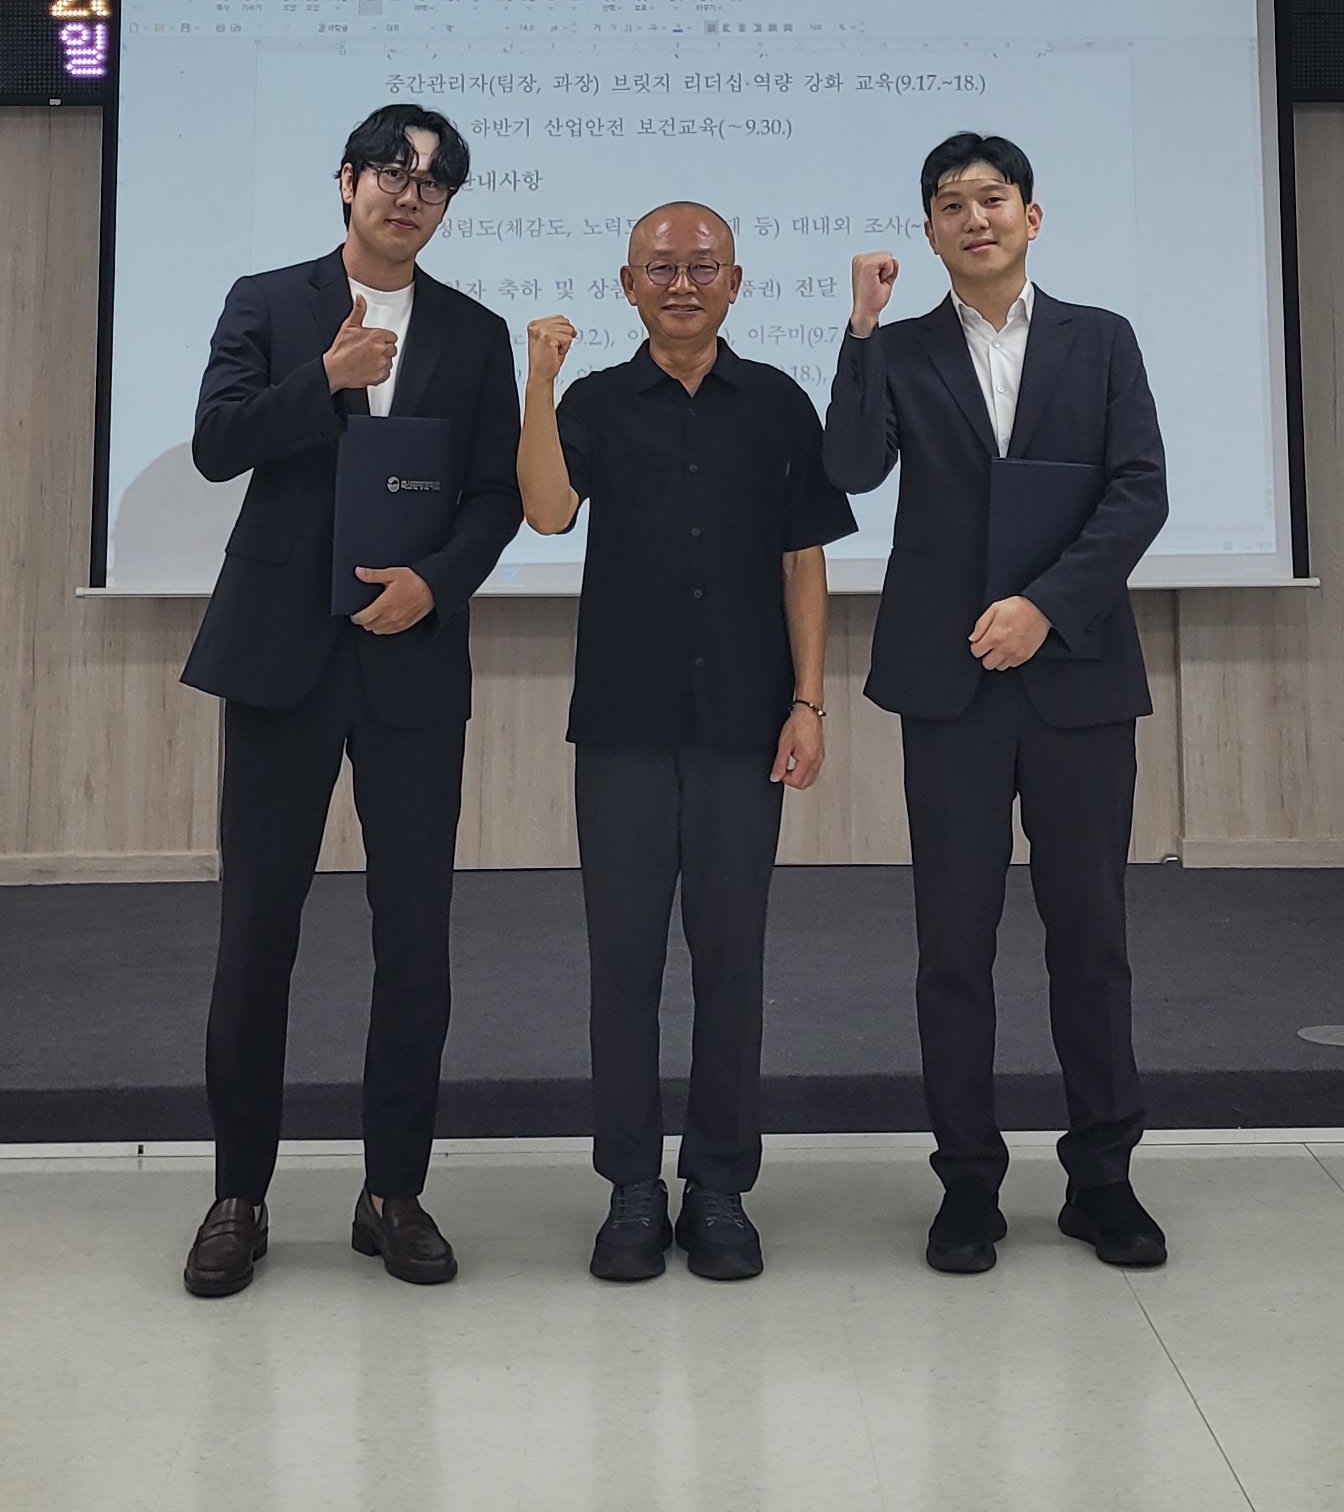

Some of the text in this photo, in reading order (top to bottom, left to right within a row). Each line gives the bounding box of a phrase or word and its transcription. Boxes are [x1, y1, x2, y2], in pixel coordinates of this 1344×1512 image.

[60, 22, 107, 76] 일
[385, 73, 543, 97] 중간관리자(팀장,
[553, 74, 601, 97] 과장)
[611, 73, 671, 93] 브릿지
[804, 73, 845, 93] 강화
[855, 73, 987, 96] 교육(9.17.~18.)
[471, 117, 531, 138] 하반기
[544, 117, 626, 138] 산업안전
[792, 216, 852, 236] 대내외
[498, 279, 543, 301] 축하
[556, 278, 574, 300] 및
[796, 276, 838, 298] 전달
